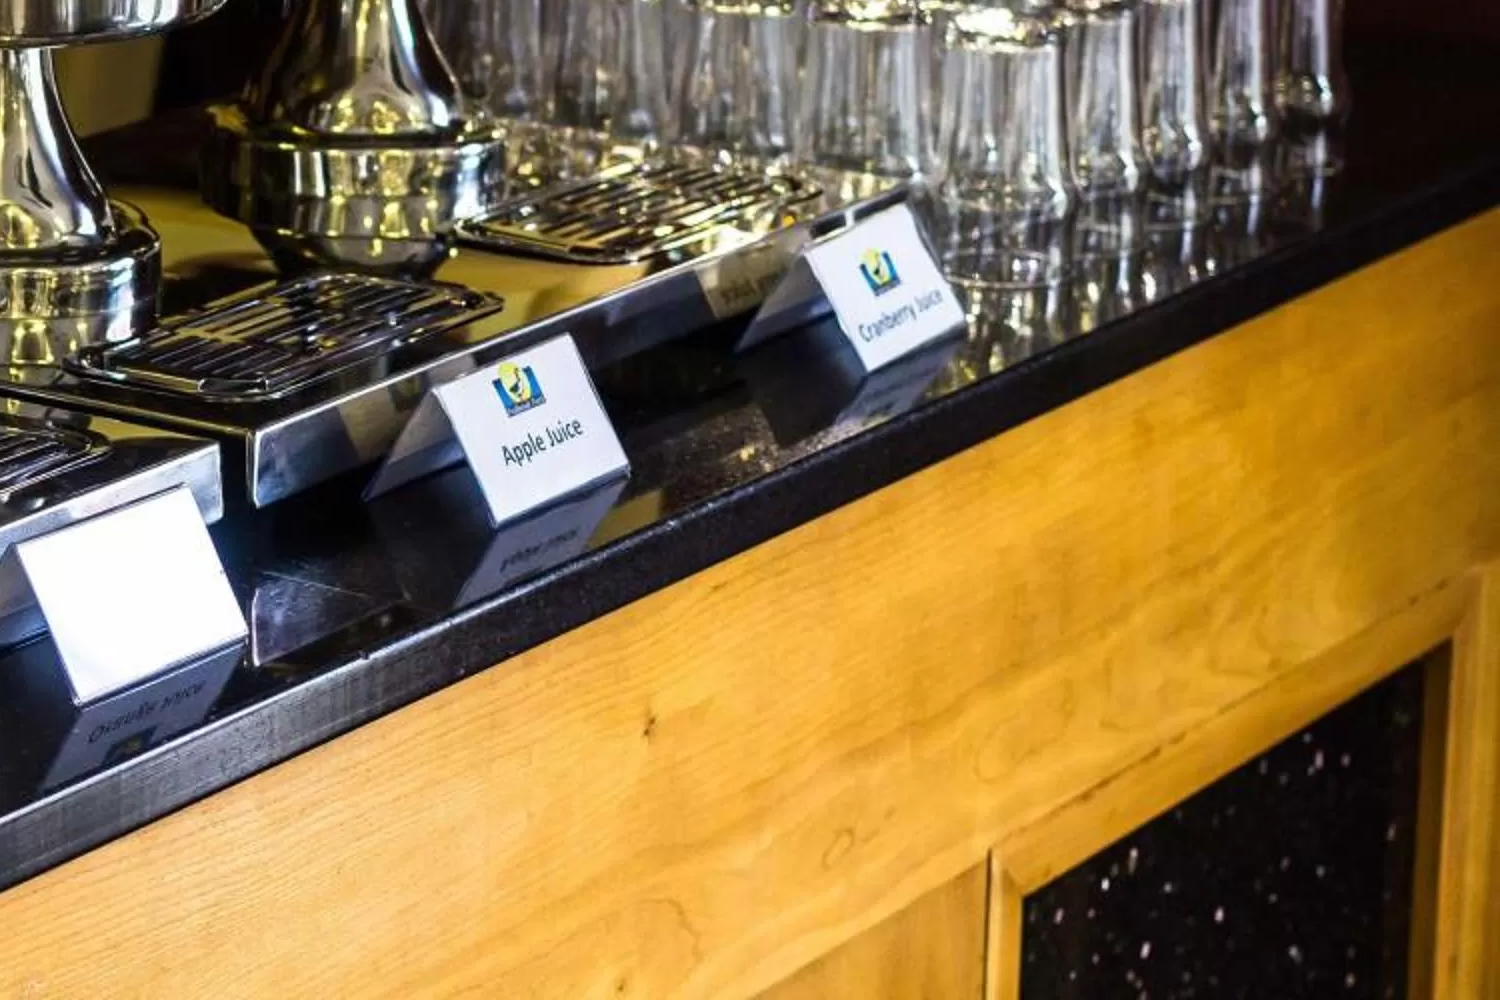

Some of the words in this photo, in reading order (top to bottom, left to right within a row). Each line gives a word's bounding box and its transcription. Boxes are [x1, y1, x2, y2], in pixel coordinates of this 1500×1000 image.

[857, 303, 917, 343] Cranberry
[914, 288, 943, 314] Juice
[501, 433, 547, 466] Apple
[547, 417, 585, 447] Juice
